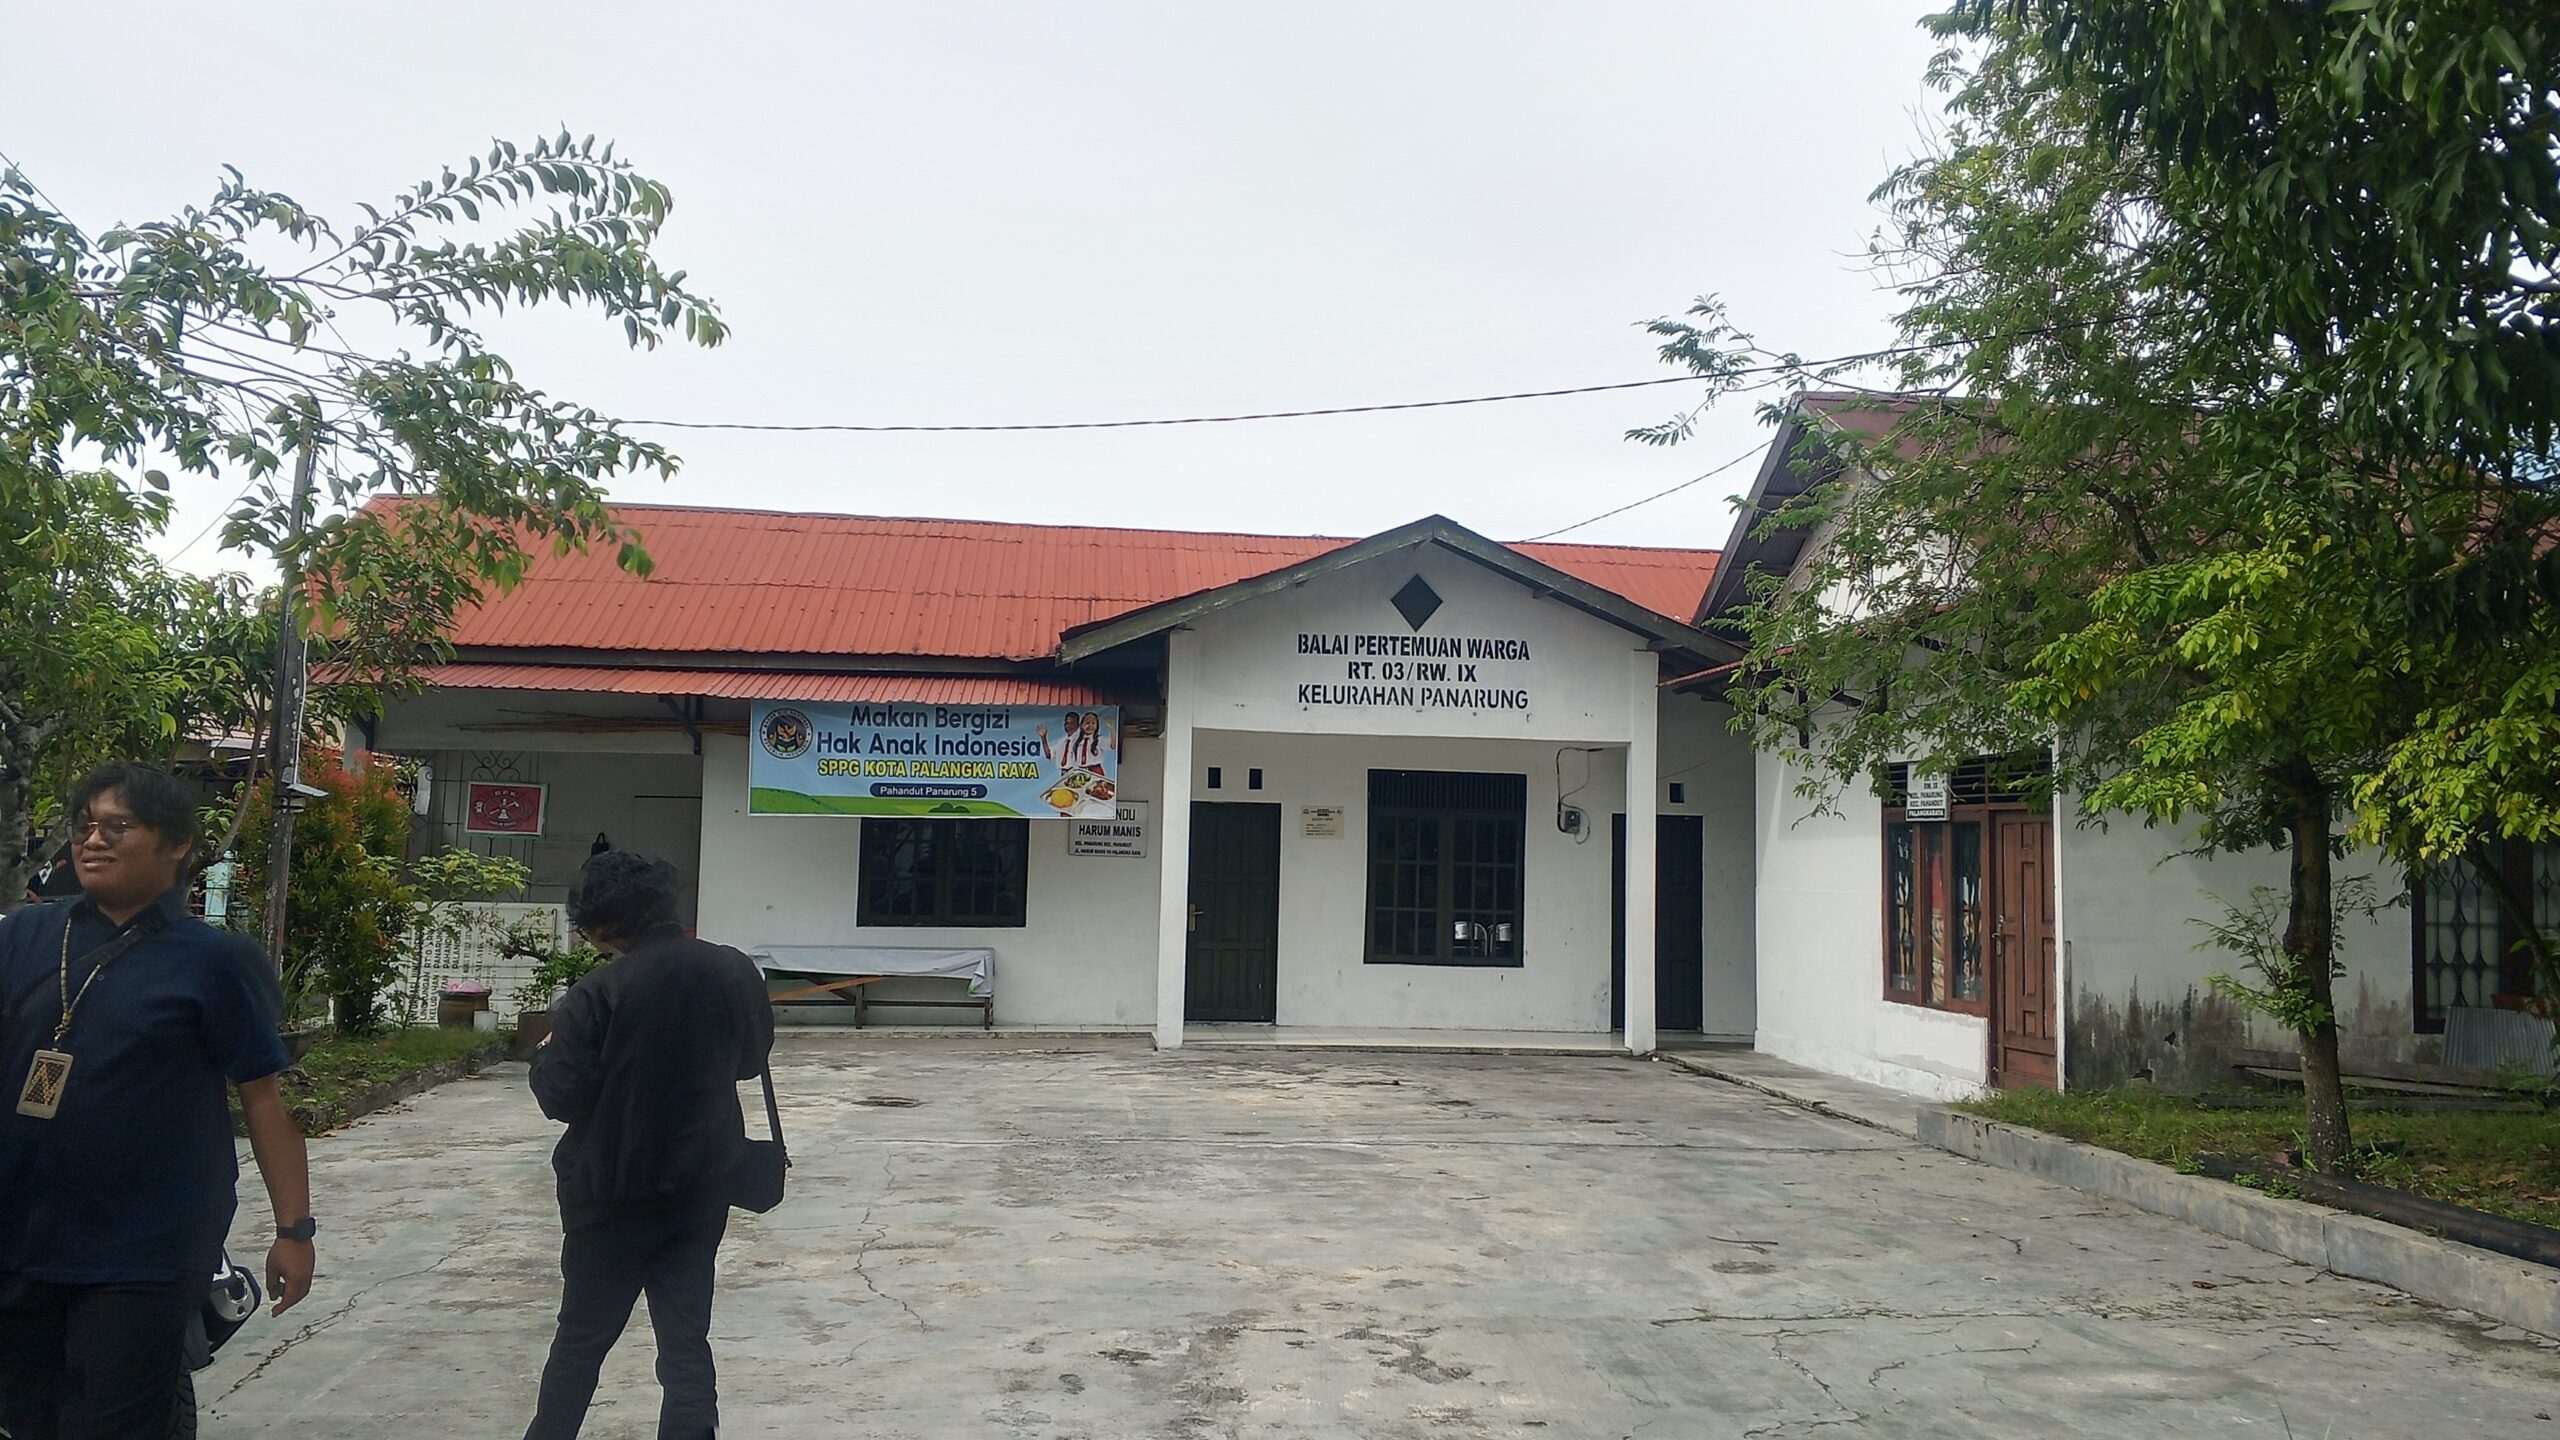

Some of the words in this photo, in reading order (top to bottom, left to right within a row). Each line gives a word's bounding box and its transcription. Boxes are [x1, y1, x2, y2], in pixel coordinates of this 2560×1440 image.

[1297, 633, 1349, 655] BALAI
[1354, 635, 1462, 658] PERTEMUAN
[1466, 638, 1530, 661] WARGA
[1348, 661, 1376, 680] RT.
[1458, 664, 1477, 683] IX
[1298, 684, 1414, 706] KELURAHAN
[1421, 687, 1529, 709] PANARUNG
[850, 705, 928, 728] Makan
[935, 706, 1010, 736] Bergizi
[816, 731, 861, 754] Hak
[869, 732, 928, 755] Anak
[935, 734, 1041, 757] Indonesia
[818, 758, 860, 776] SPPG
[864, 760, 907, 778] KOTA
[910, 761, 995, 778] PALANGKA
[997, 762, 1039, 779] RAYA
[880, 786, 924, 795] Pahandut
[925, 787, 969, 797] Panarung
[971, 788, 978, 796] 5
[1078, 824, 1110, 836] HARUM
[1113, 825, 1141, 837] MANIS
